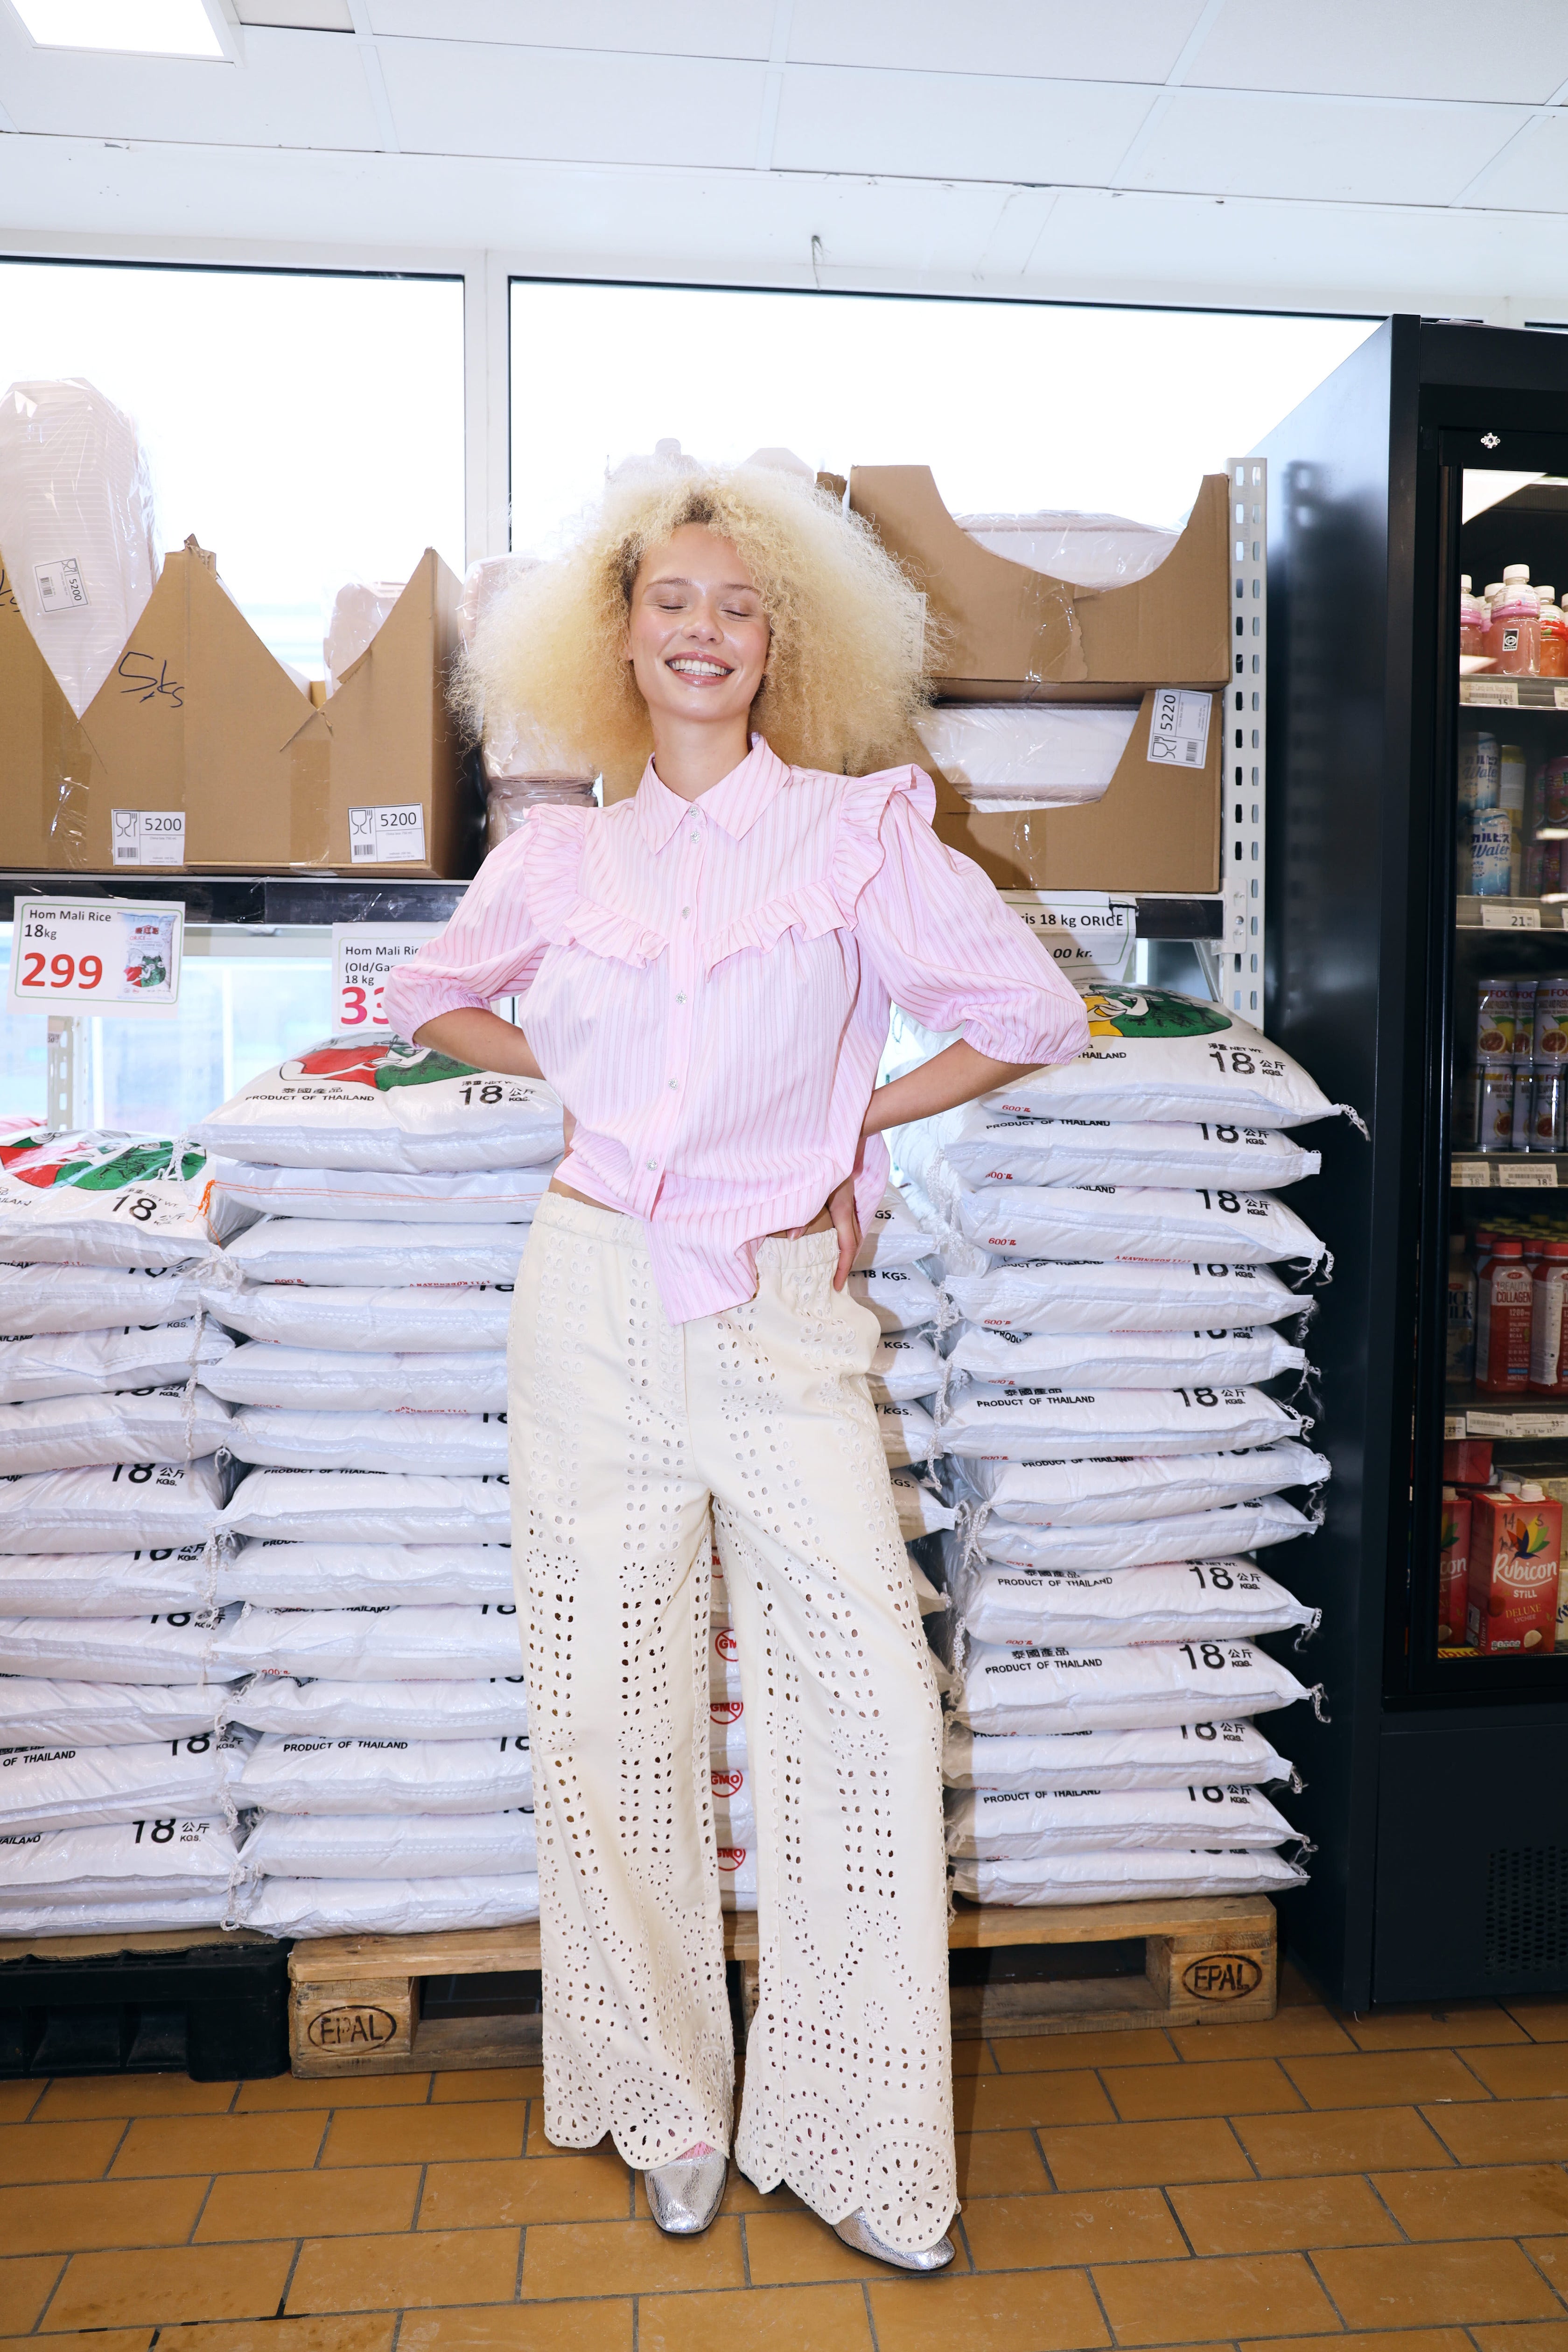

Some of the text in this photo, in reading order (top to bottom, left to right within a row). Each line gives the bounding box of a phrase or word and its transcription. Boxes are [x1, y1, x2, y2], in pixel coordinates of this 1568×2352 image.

[70, 579, 82, 601] 5200
[1160, 695, 1176, 731] 5220
[145, 818, 182, 831] 5200
[381, 812, 416, 826] 5200
[1472, 844, 1510, 858] Water
[30, 910, 111, 921] Hom Mali Rice
[1041, 914, 1056, 924] 18
[1061, 915, 1076, 928] kg
[1081, 915, 1123, 926] ORICE
[1512, 916, 1526, 926] 21
[346, 946, 371, 955] Hom
[376, 946, 400, 955] Mali
[1076, 948, 1092, 958] kr.
[22, 952, 102, 989] 299
[345, 962, 396, 973] (Old/Ga
[345, 975, 374, 986] 18 kg
[1209, 1051, 1255, 1074] 18
[1260, 1059, 1286, 1071] 公斤
[459, 1085, 503, 1105] 18
[509, 1088, 537, 1096] 公斤
[986, 1120, 1035, 1129] PRODUCT
[1197, 1122, 1239, 1143] 18
[1243, 1128, 1269, 1139] 公斤
[146, 1192, 162, 1202] NET
[1196, 1188, 1241, 1213] 18
[112, 1195, 157, 1221] 18
[1245, 1199, 1270, 1210] 公斤
[875, 1210, 895, 1219] GS.
[861, 1270, 910, 1281] 18 KGS.
[1449, 1292, 1473, 1305] ICE
[1497, 1292, 1531, 1303] COLLAGEN
[1449, 1306, 1472, 1319] ILK
[1173, 1387, 1219, 1407] 18
[1220, 1389, 1246, 1398] 公斤
[977, 1398, 1023, 1407] PRODUCT
[1048, 1395, 1095, 1405] THAILAND
[883, 1406, 912, 1416] KGS.
[1022, 1459, 1065, 1468] PRODUCT
[112, 1463, 155, 1483] 18
[160, 1467, 186, 1479] 公斤
[156, 1478, 177, 1486] KGS.
[1493, 1553, 1558, 1583] Rubicon
[997, 1578, 1043, 1586] PRODUCT
[1065, 1577, 1113, 1586] THAILAND
[1189, 1567, 1234, 1590] 18
[1237, 1572, 1261, 1582] 公斤
[1505, 1604, 1542, 1618] DELUXE
[1514, 1614, 1536, 1624] LYCHEE
[1011, 1648, 1069, 1659] 泰國產品
[1179, 1644, 1225, 1670] 18
[1228, 1649, 1253, 1659] 公斤
[985, 1658, 1102, 1674] PRODUCT OF THAILAND
[710, 1702, 741, 1712] GMO
[1220, 1722, 1245, 1734] 公斤
[164, 1733, 210, 1756] 18
[283, 1742, 333, 1752] PRODUCT
[358, 1741, 408, 1750] THAILAND
[3, 1757, 18, 1767] OF
[23, 1750, 76, 1764] THAILAND
[711, 1775, 740, 1785] GMO
[983, 1792, 1029, 1804] PRODUCT
[132, 1819, 176, 1844] 18
[182, 1821, 210, 1834] 公斤
[1194, 1965, 1249, 1991] EPAL
[320, 2017, 385, 2046] EPAL
